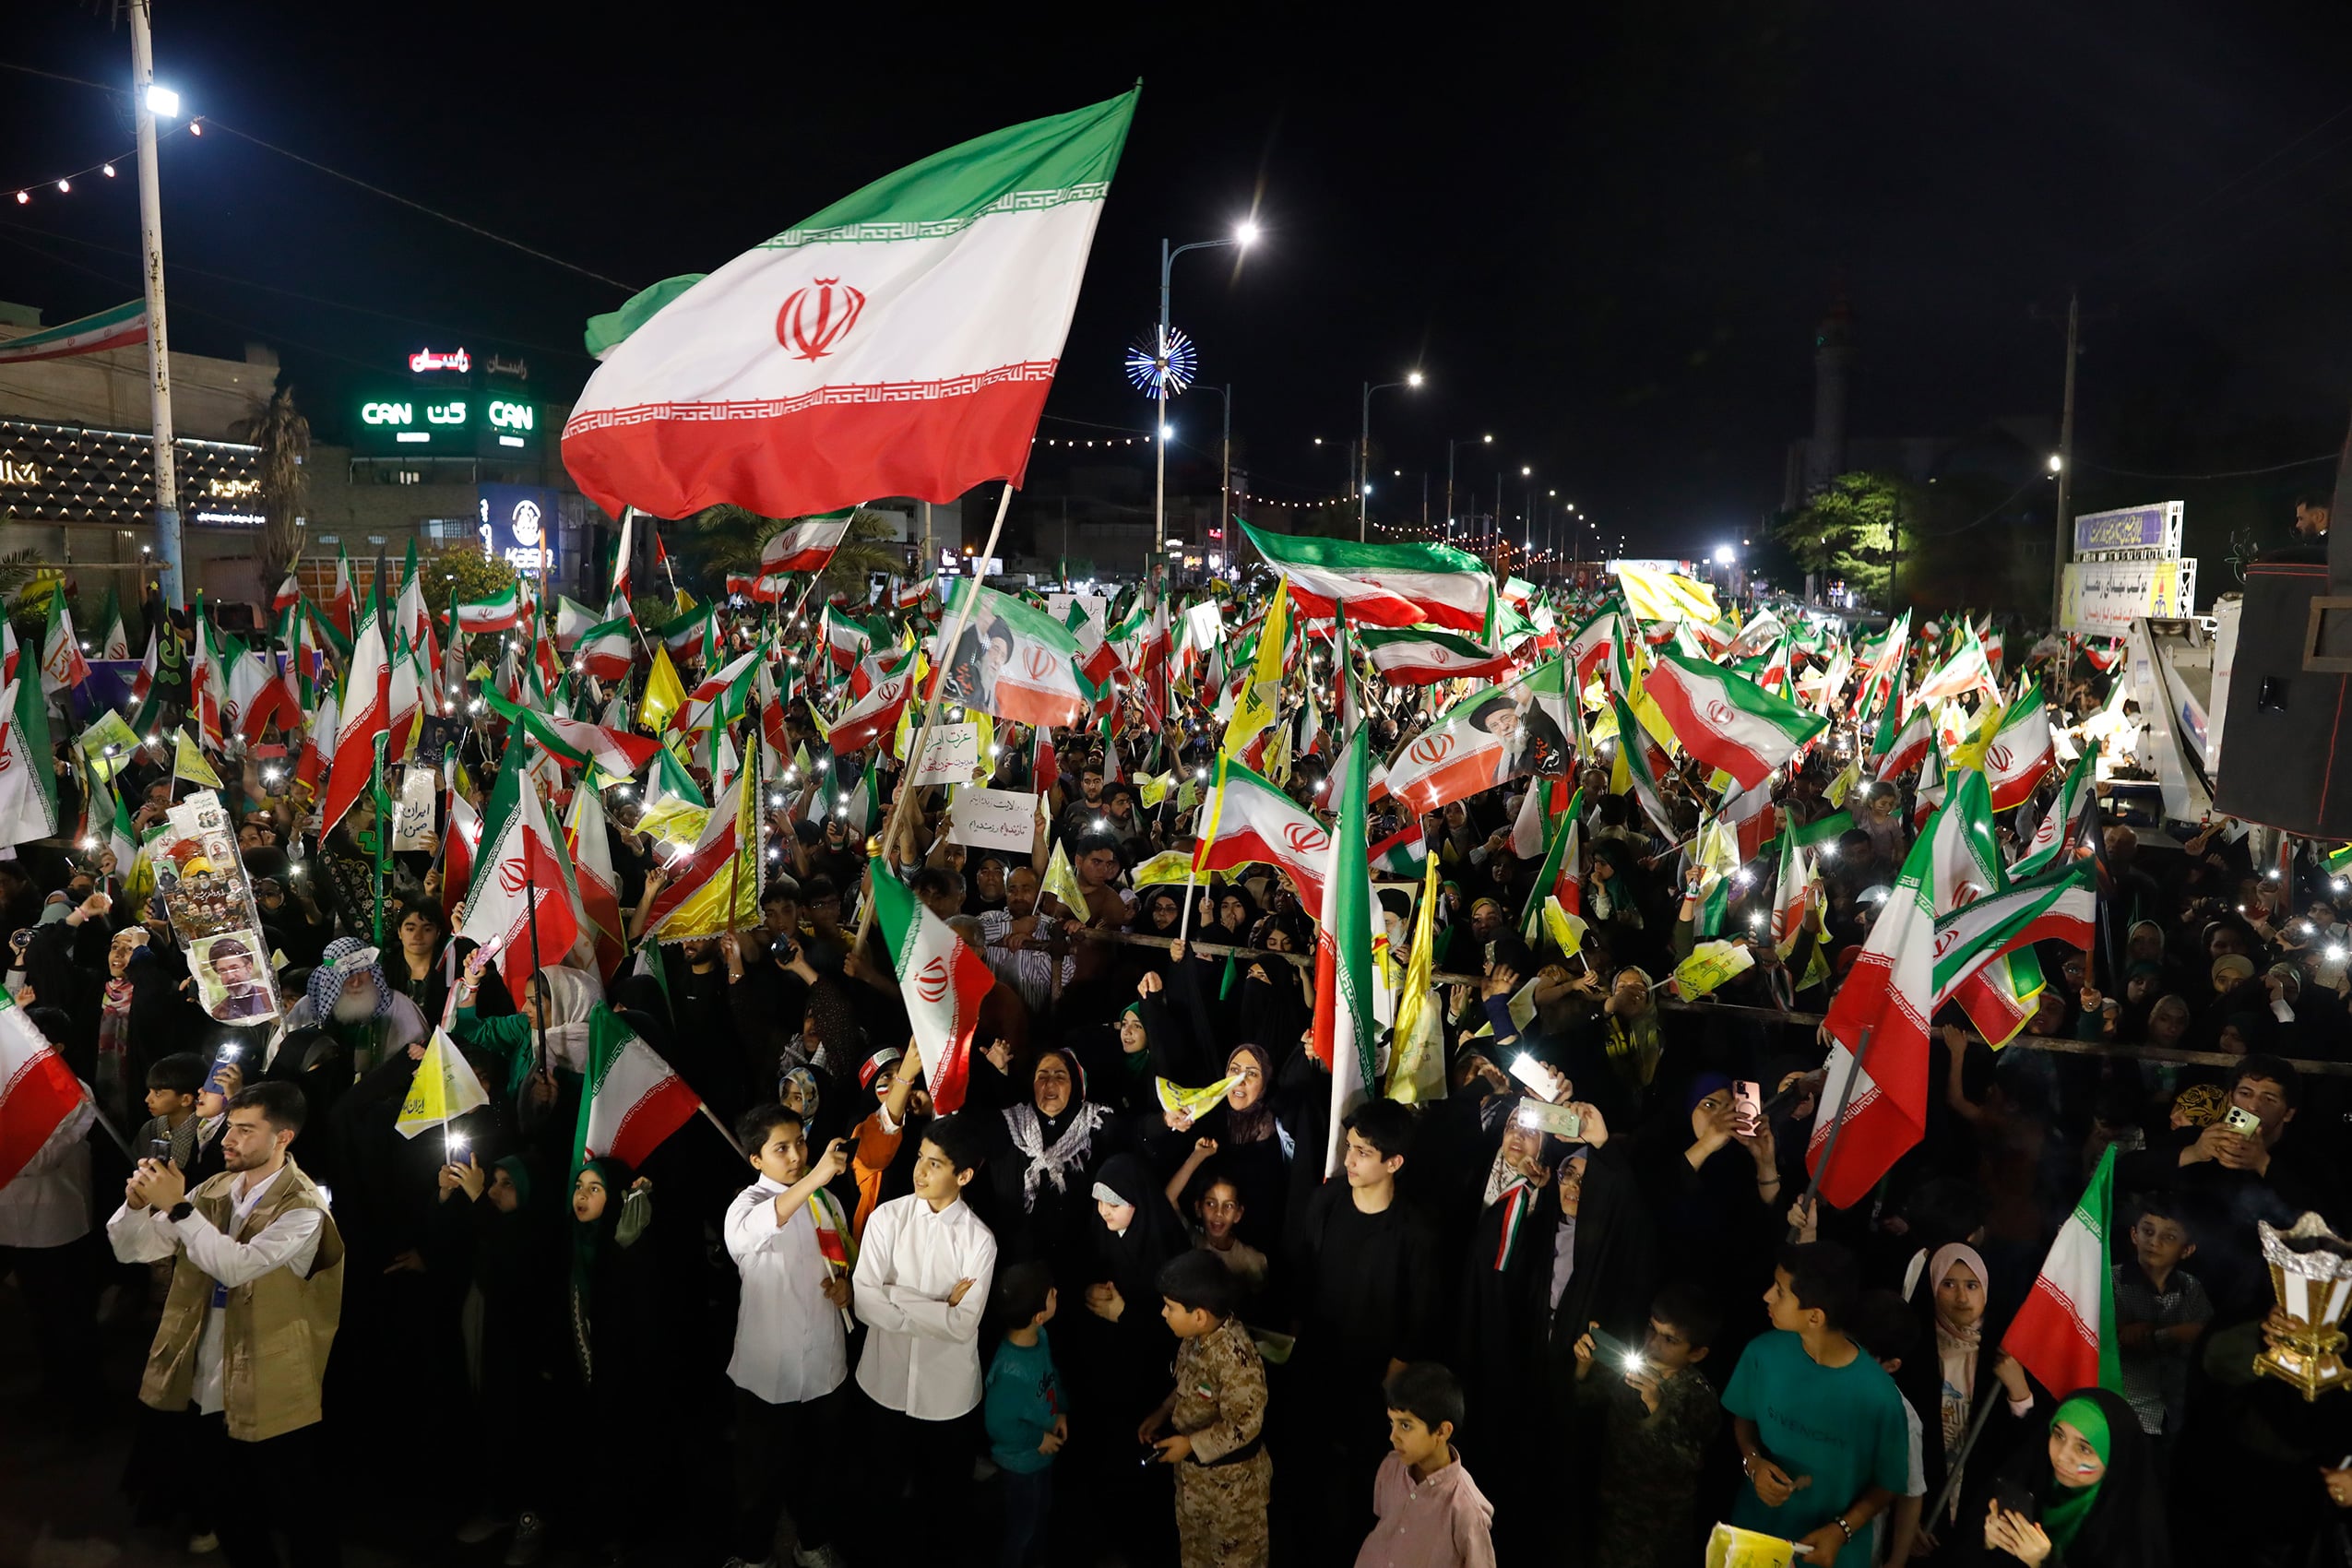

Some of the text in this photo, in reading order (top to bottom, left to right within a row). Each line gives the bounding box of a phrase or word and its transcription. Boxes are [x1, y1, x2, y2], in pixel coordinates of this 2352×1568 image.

[362, 402, 412, 424] CAN
[489, 401, 533, 430] CAN
[946, 729, 972, 749] عزت
[933, 758, 954, 772] خون
[403, 801, 430, 821] ایران
[408, 1099, 424, 1114] ایران
